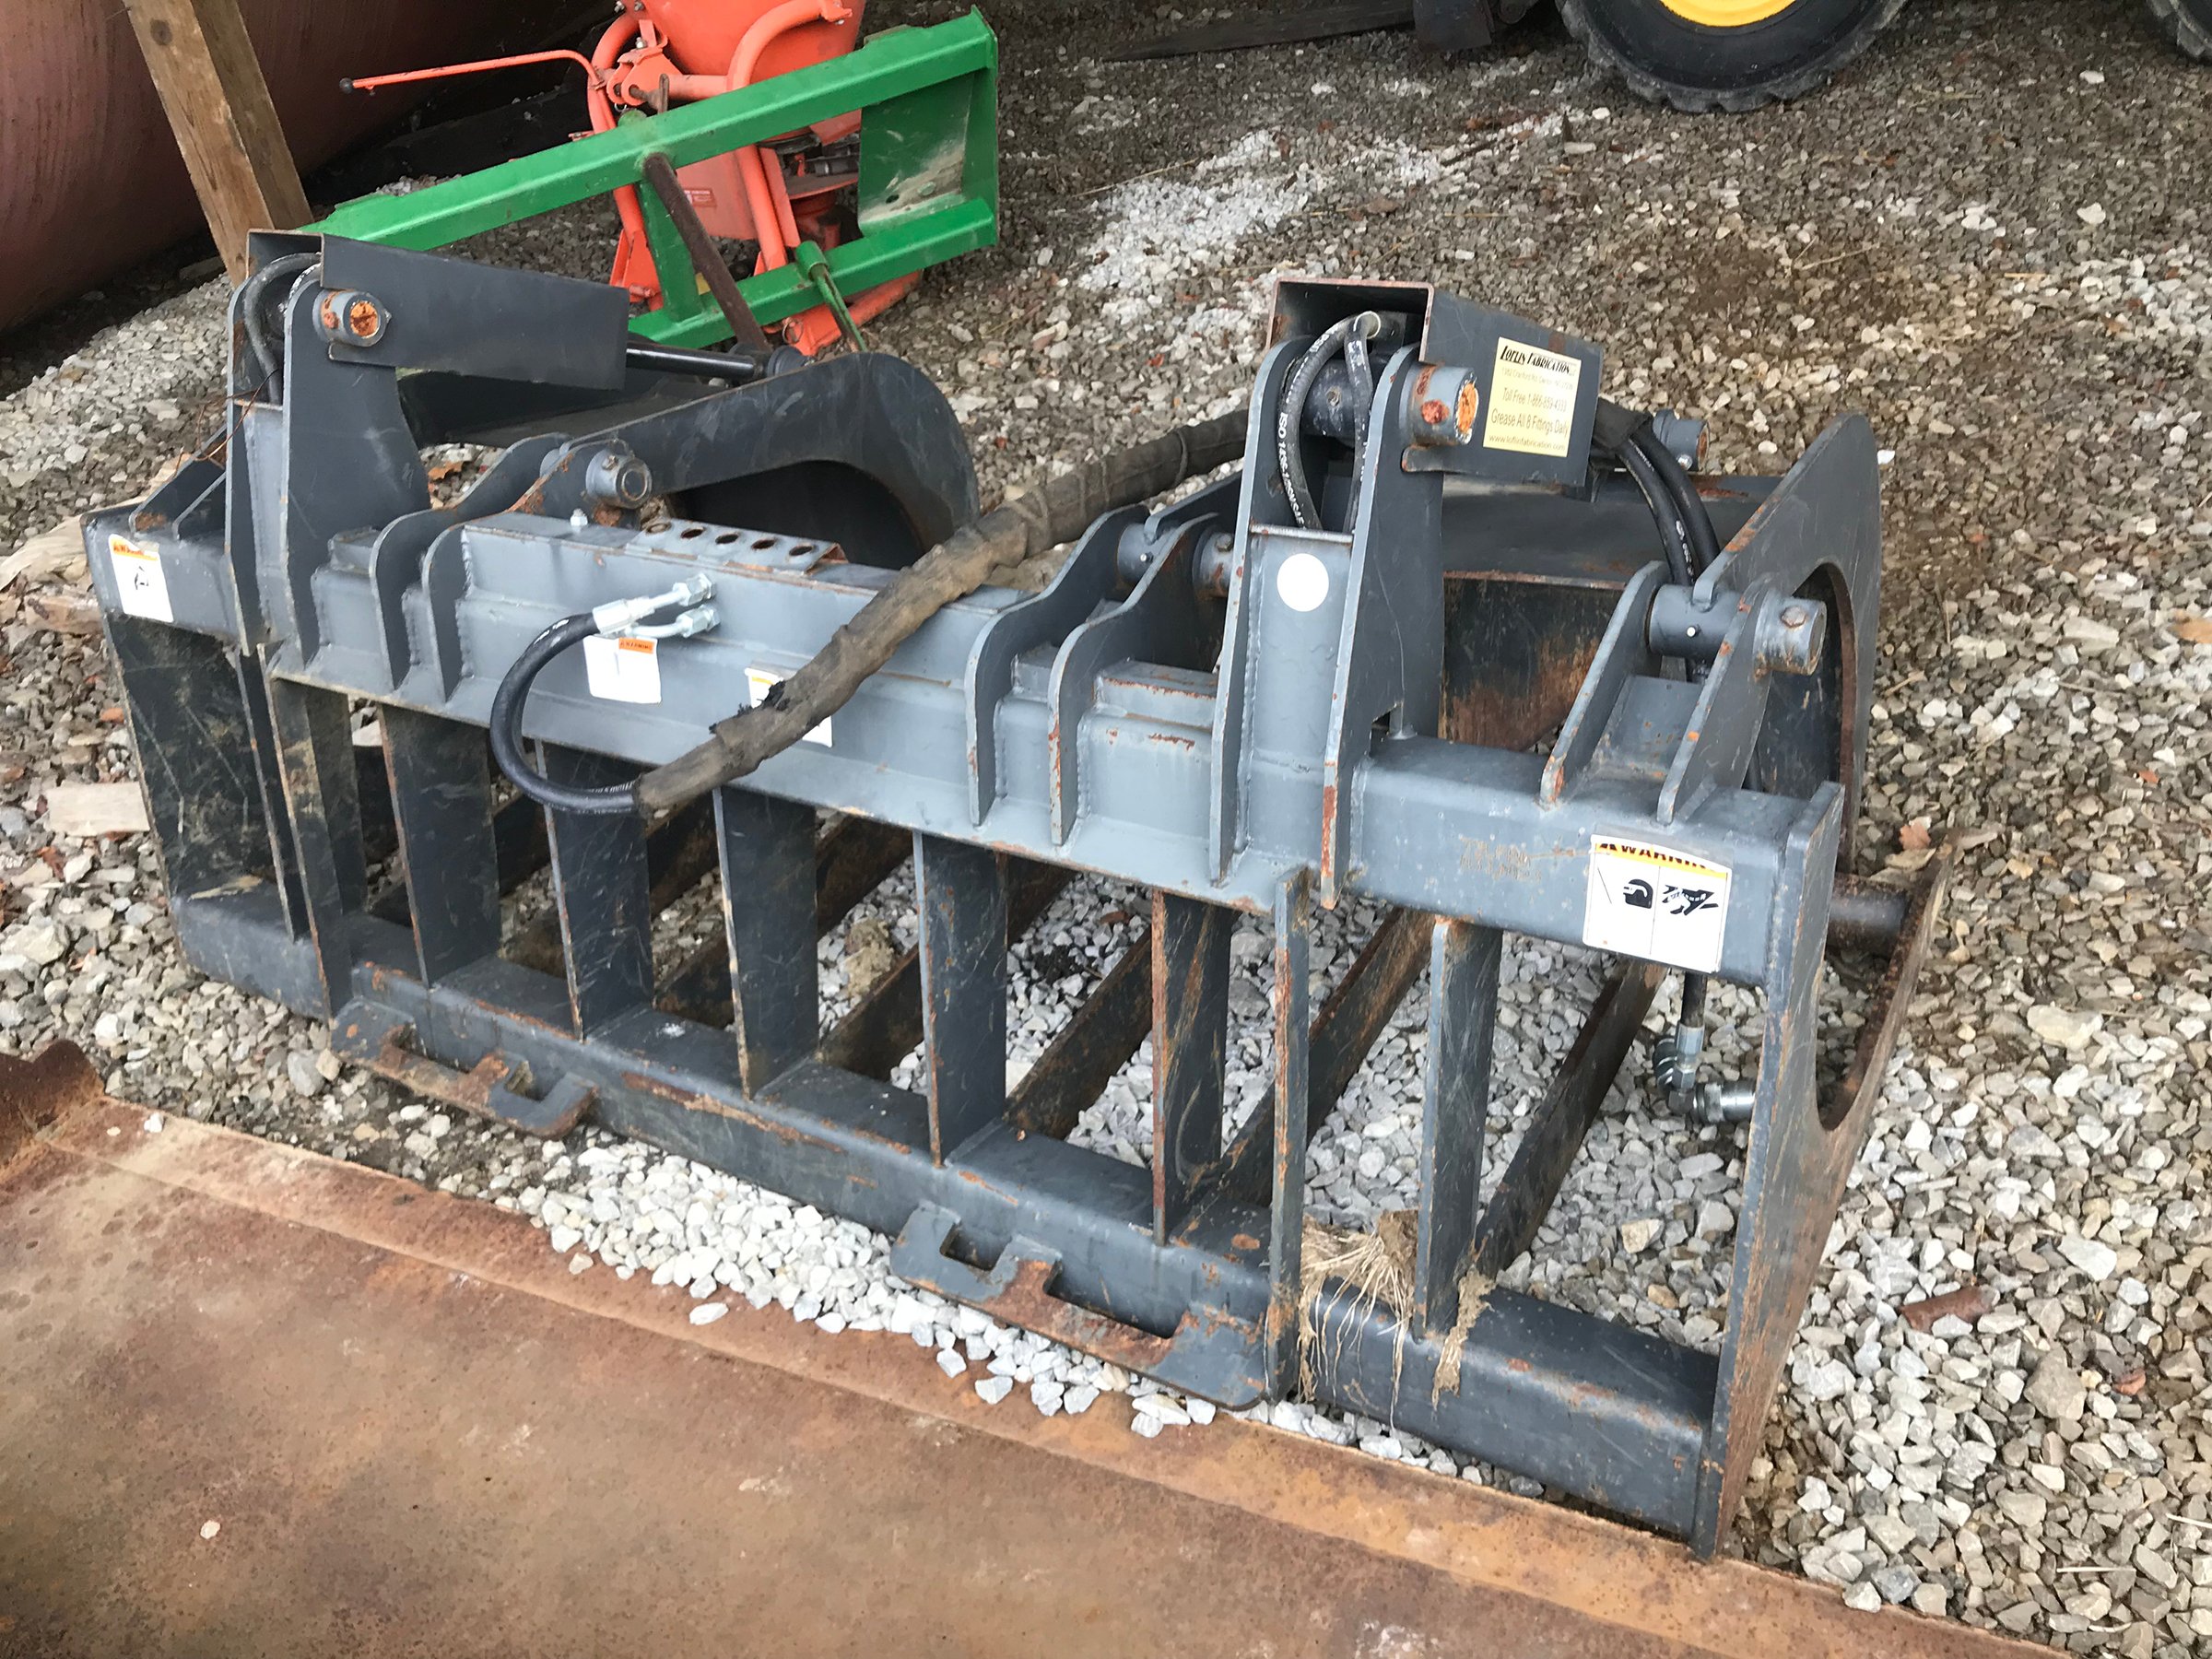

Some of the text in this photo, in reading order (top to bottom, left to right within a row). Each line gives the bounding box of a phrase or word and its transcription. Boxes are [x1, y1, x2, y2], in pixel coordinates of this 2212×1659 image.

[1527, 352, 1571, 374] FABRICATION
[1502, 387, 1513, 402] Toll
[1512, 388, 1526, 405] Free
[1491, 407, 1516, 427] Grease
[1516, 412, 1526, 427] All
[1532, 415, 1553, 436] Fittings
[1554, 418, 1569, 438] Daily
